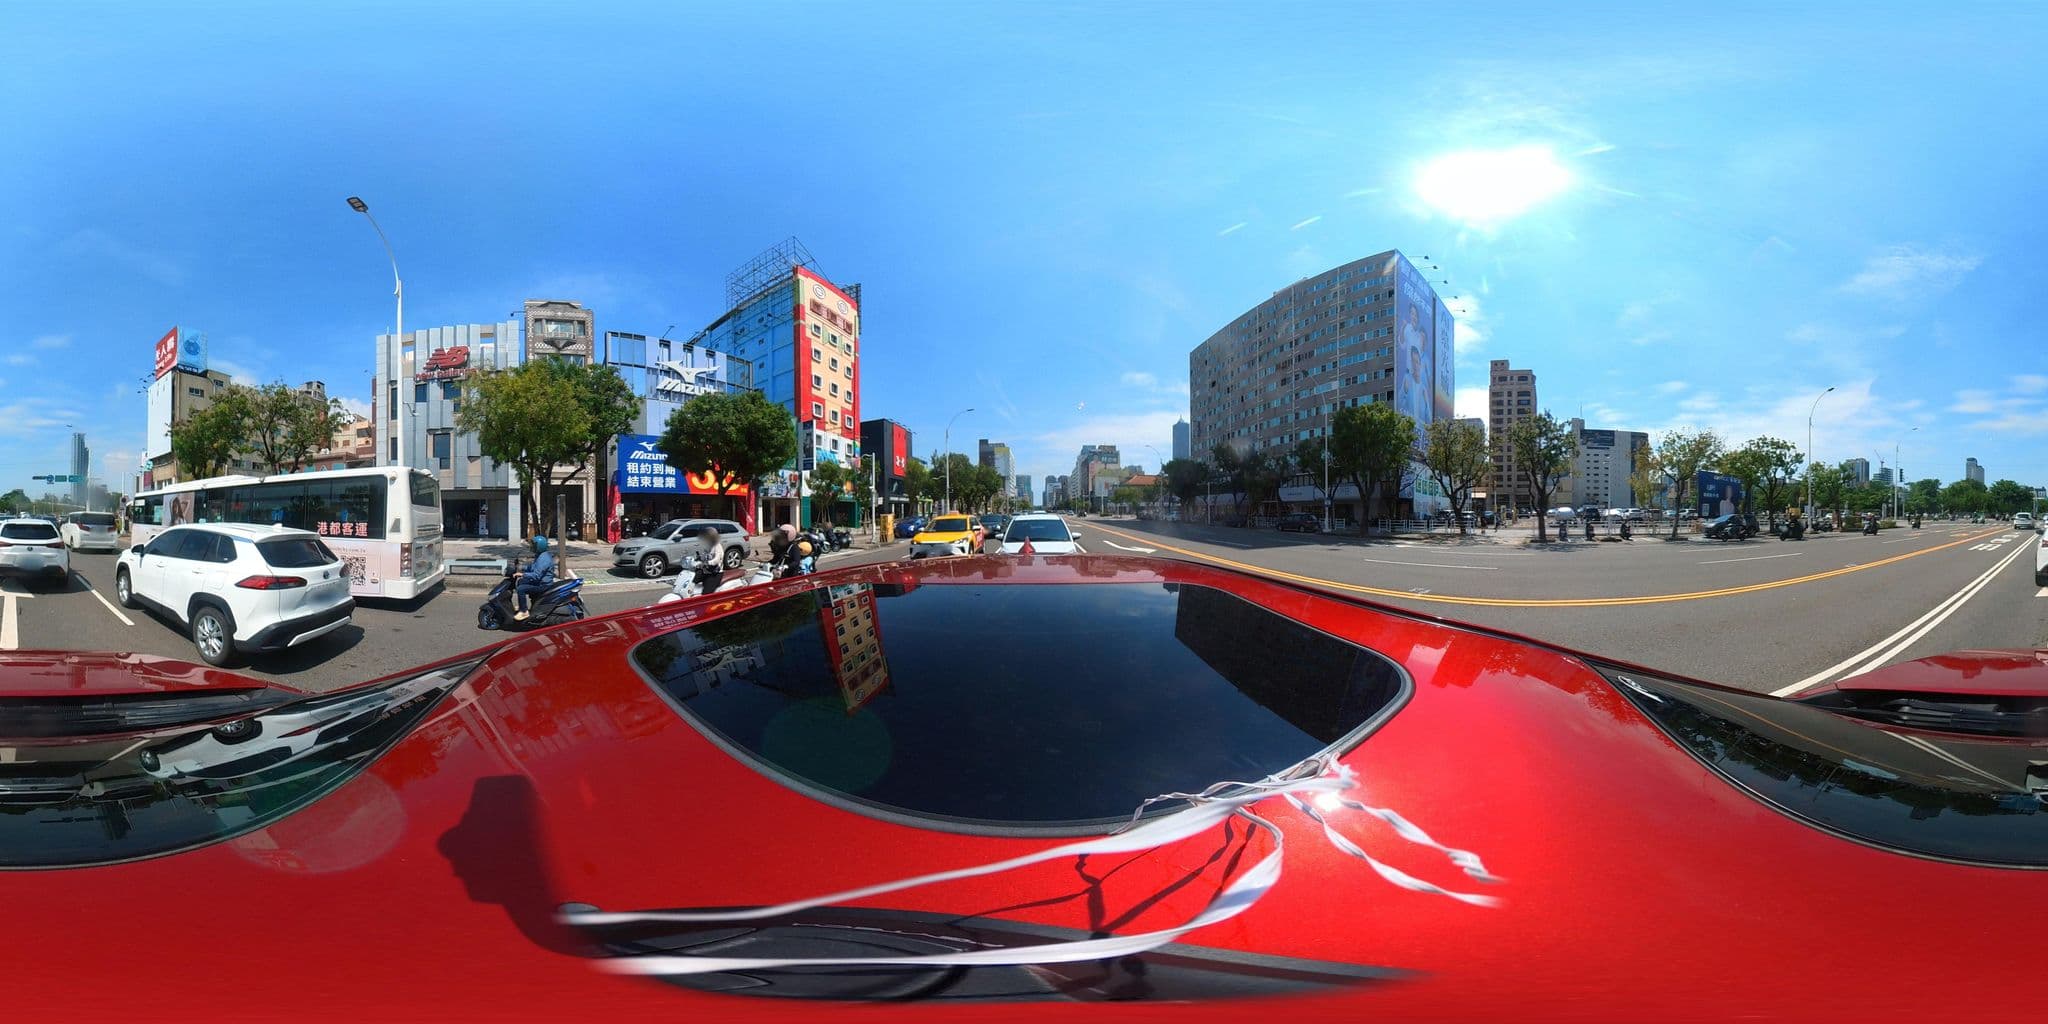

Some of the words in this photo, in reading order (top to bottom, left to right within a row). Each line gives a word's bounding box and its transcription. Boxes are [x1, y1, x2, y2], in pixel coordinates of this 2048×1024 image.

[626, 475, 677, 489] 結束營業
[317, 521, 368, 537] 港都客運
